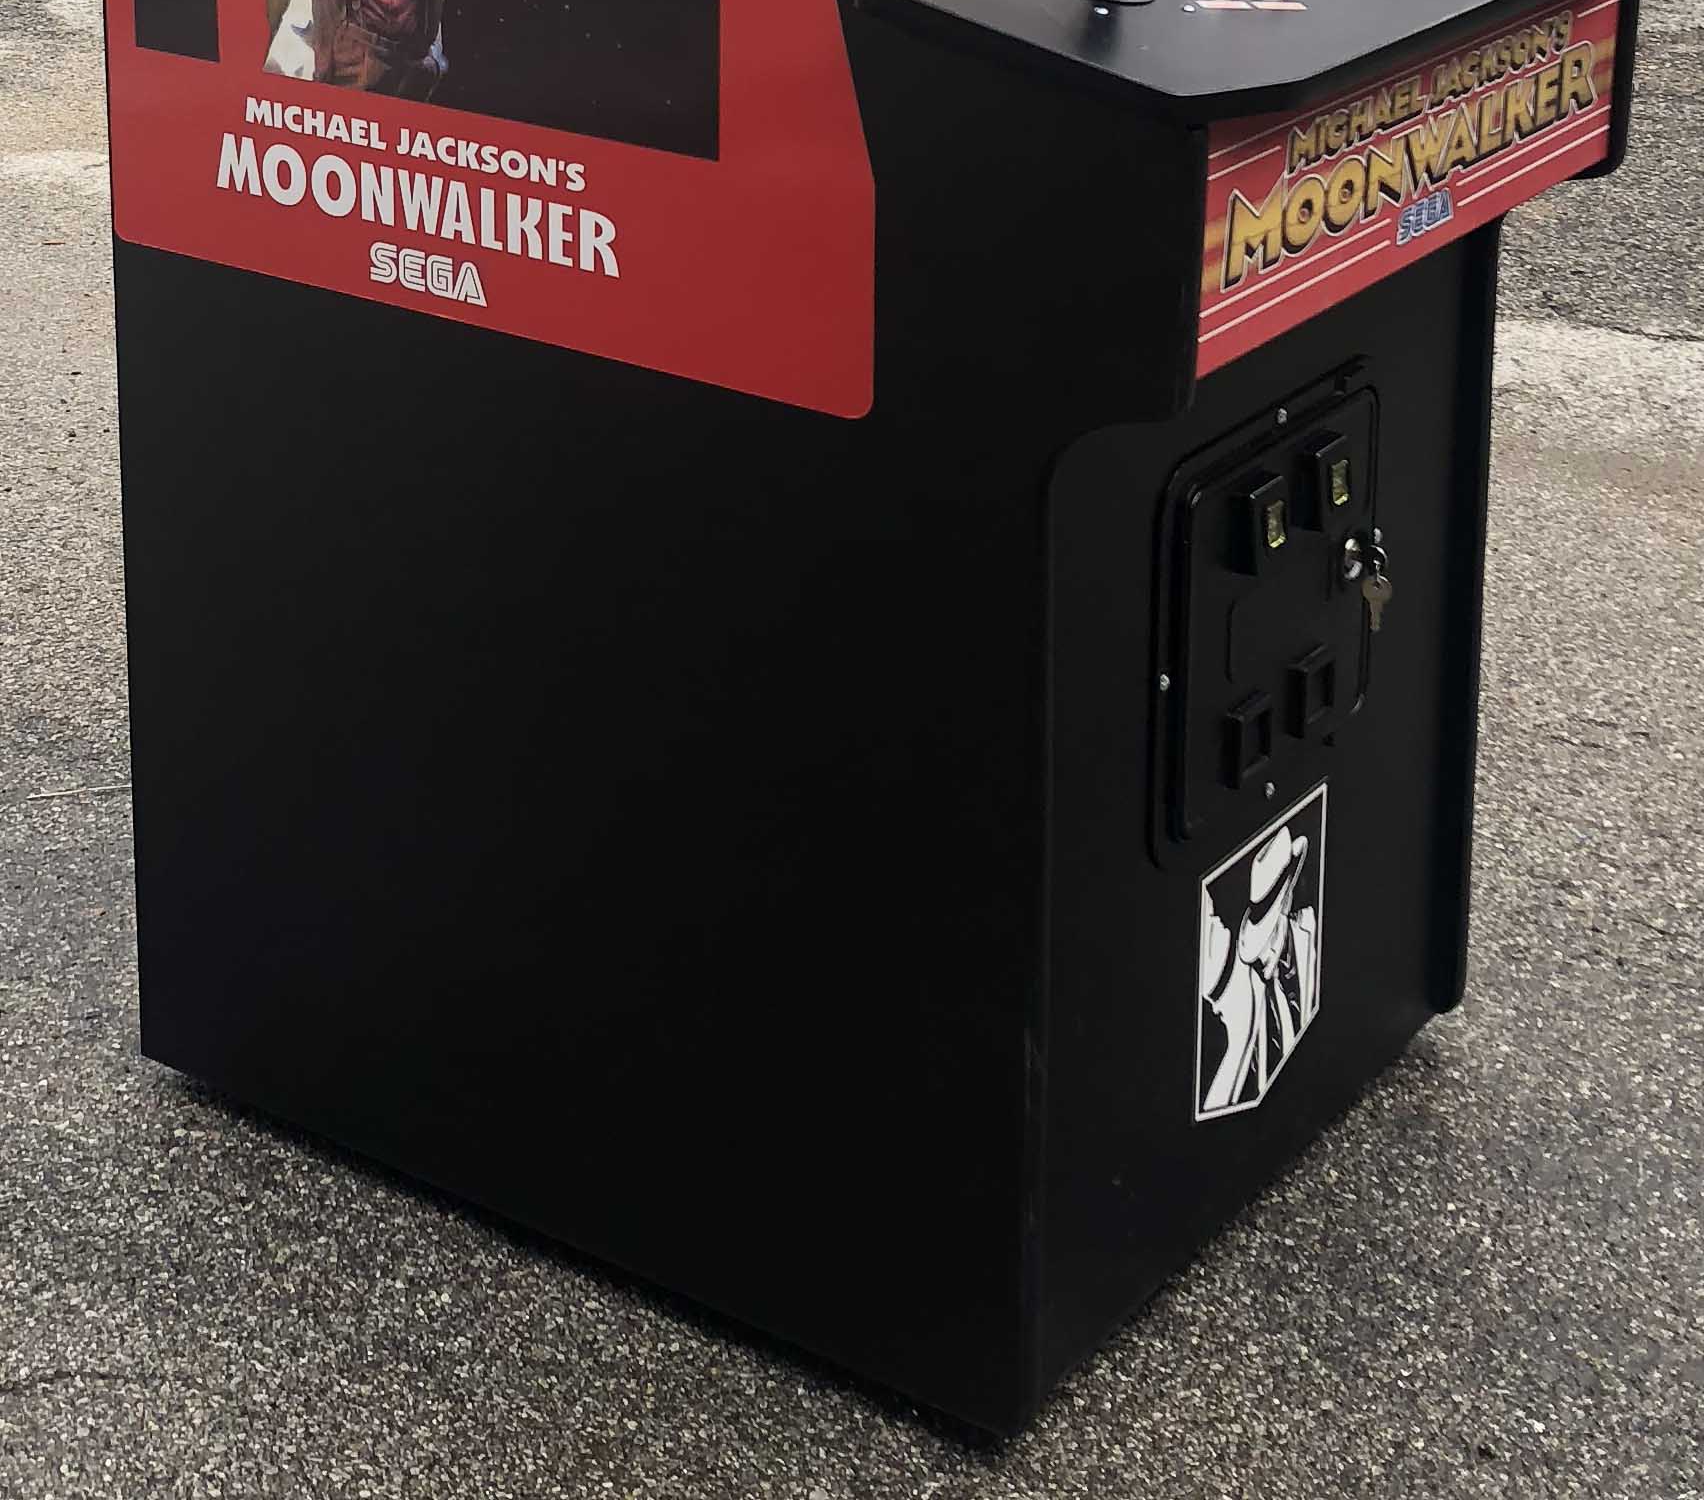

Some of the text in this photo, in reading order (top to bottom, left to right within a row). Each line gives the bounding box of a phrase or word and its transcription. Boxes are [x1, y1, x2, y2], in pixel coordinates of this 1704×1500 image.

[245, 96, 586, 192] MICHAEL JACKSON'S
[1287, 10, 1574, 174] MICHAEL JACKSON'S
[216, 132, 621, 278] MOONWALKER
[1220, 41, 1599, 293] MOONWALKER
[1396, 188, 1454, 244] SEGA
[369, 241, 488, 307] SEGA
